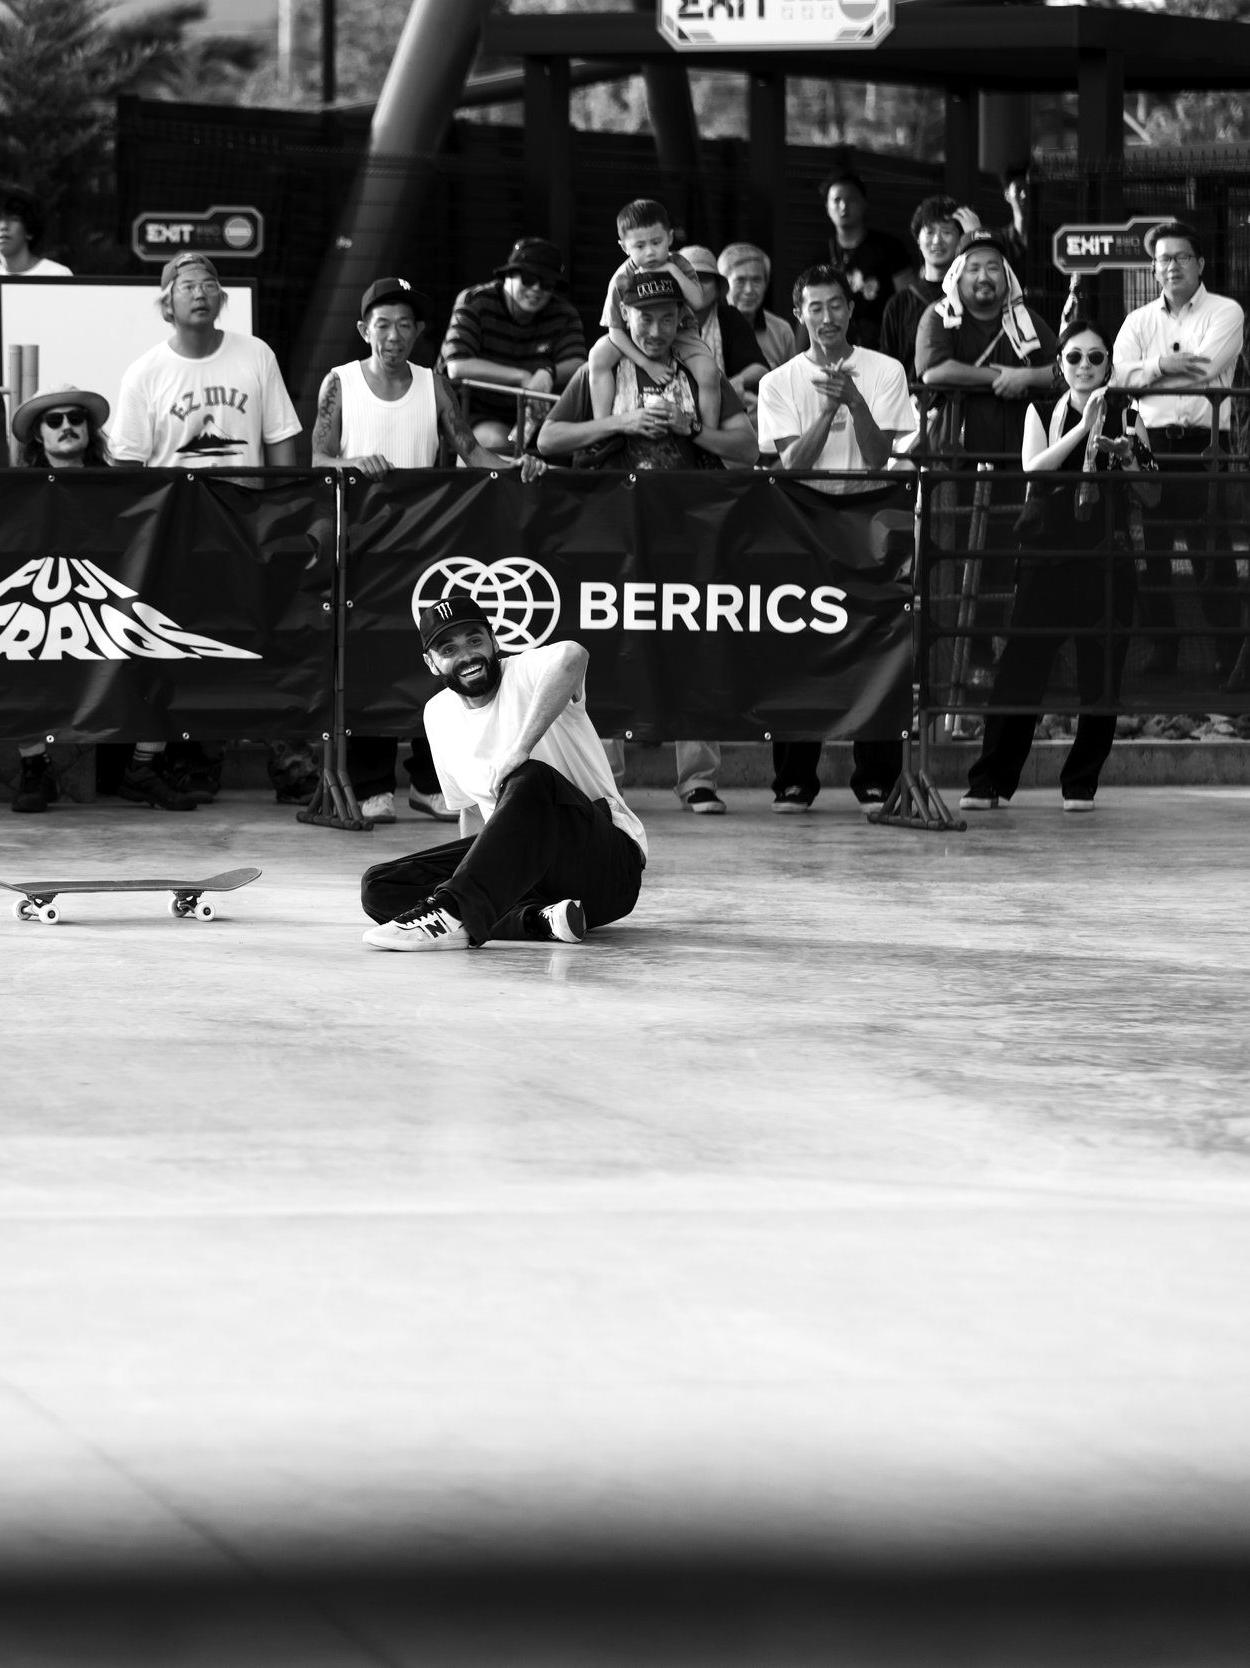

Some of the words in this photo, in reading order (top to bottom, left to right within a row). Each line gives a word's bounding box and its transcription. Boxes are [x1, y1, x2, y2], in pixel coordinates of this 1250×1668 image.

[145, 223, 195, 243] EXIT
[1066, 234, 1115, 256] EXIT
[169, 390, 201, 422] EZ
[579, 582, 849, 634] BERRICS
